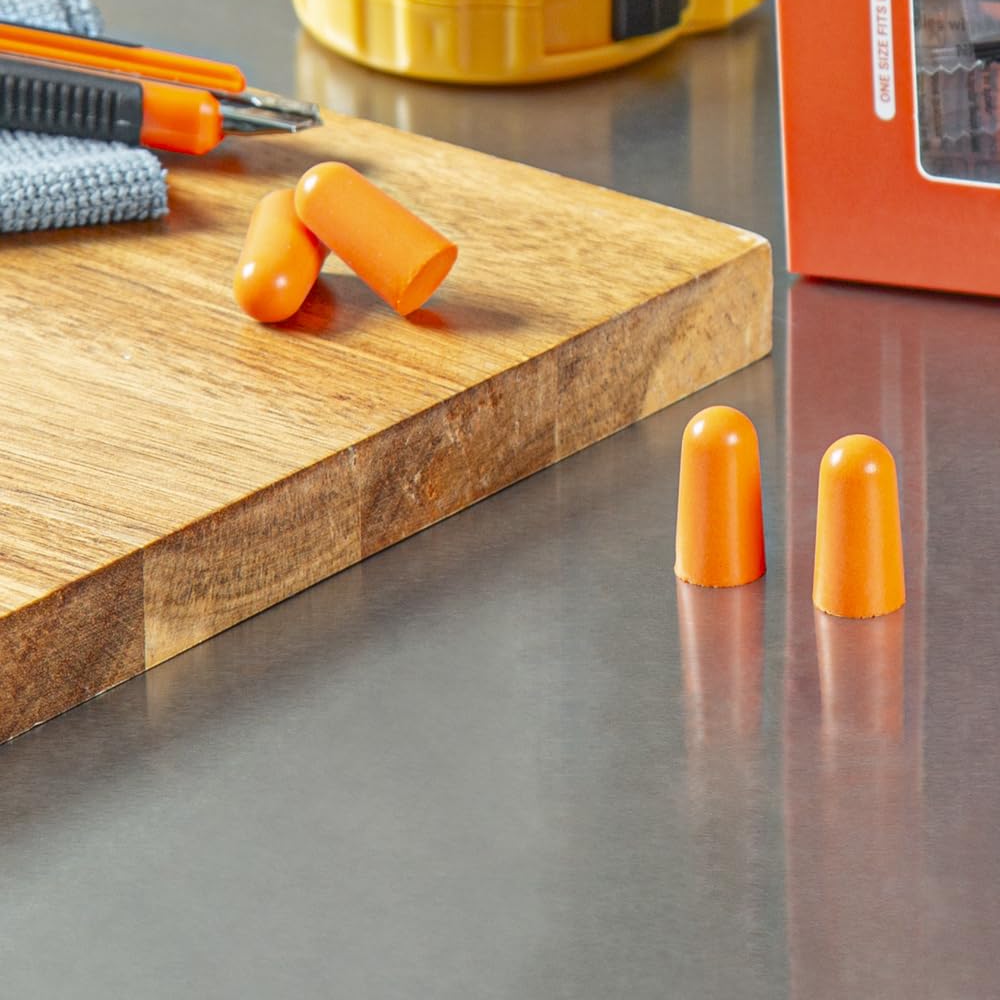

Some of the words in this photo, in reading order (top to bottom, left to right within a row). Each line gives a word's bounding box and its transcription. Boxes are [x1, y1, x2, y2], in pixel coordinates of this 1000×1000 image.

[876, 5, 888, 36] FITS
[878, 40, 890, 70] SIZE
[879, 74, 891, 103] ONE
